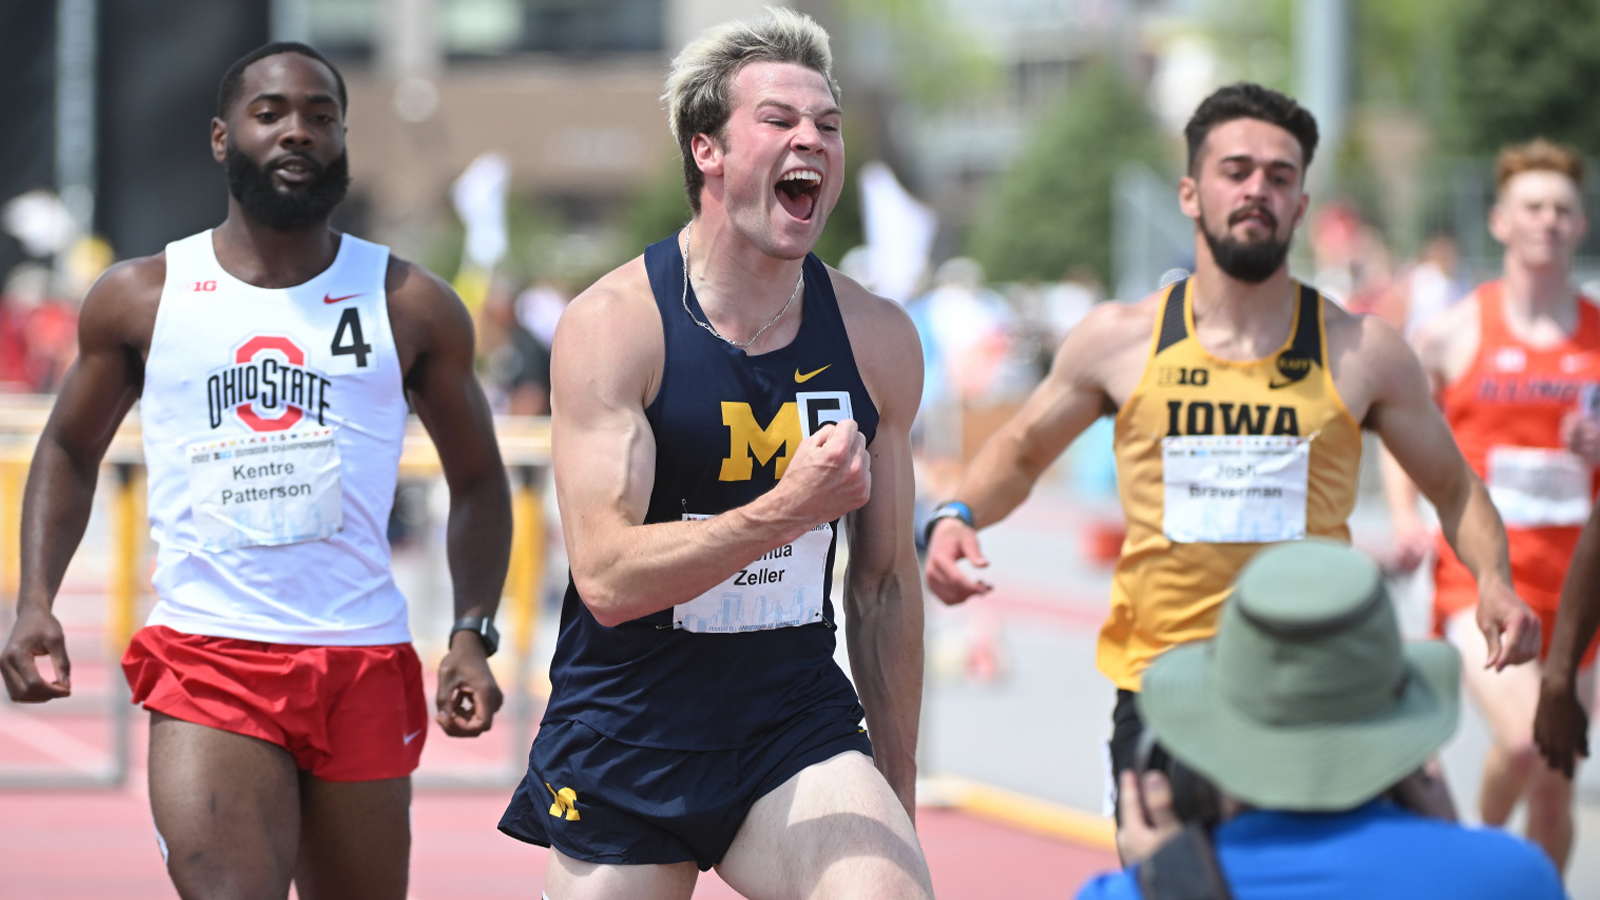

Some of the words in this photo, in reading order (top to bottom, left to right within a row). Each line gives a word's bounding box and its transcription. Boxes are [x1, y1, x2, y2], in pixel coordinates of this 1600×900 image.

[331, 307, 372, 368] 4
[1165, 401, 1300, 436] IOWA
[718, 401, 803, 482] M
[233, 462, 295, 480] Kentre
[222, 483, 312, 505] Patterson
[733, 567, 785, 587] Zeller
